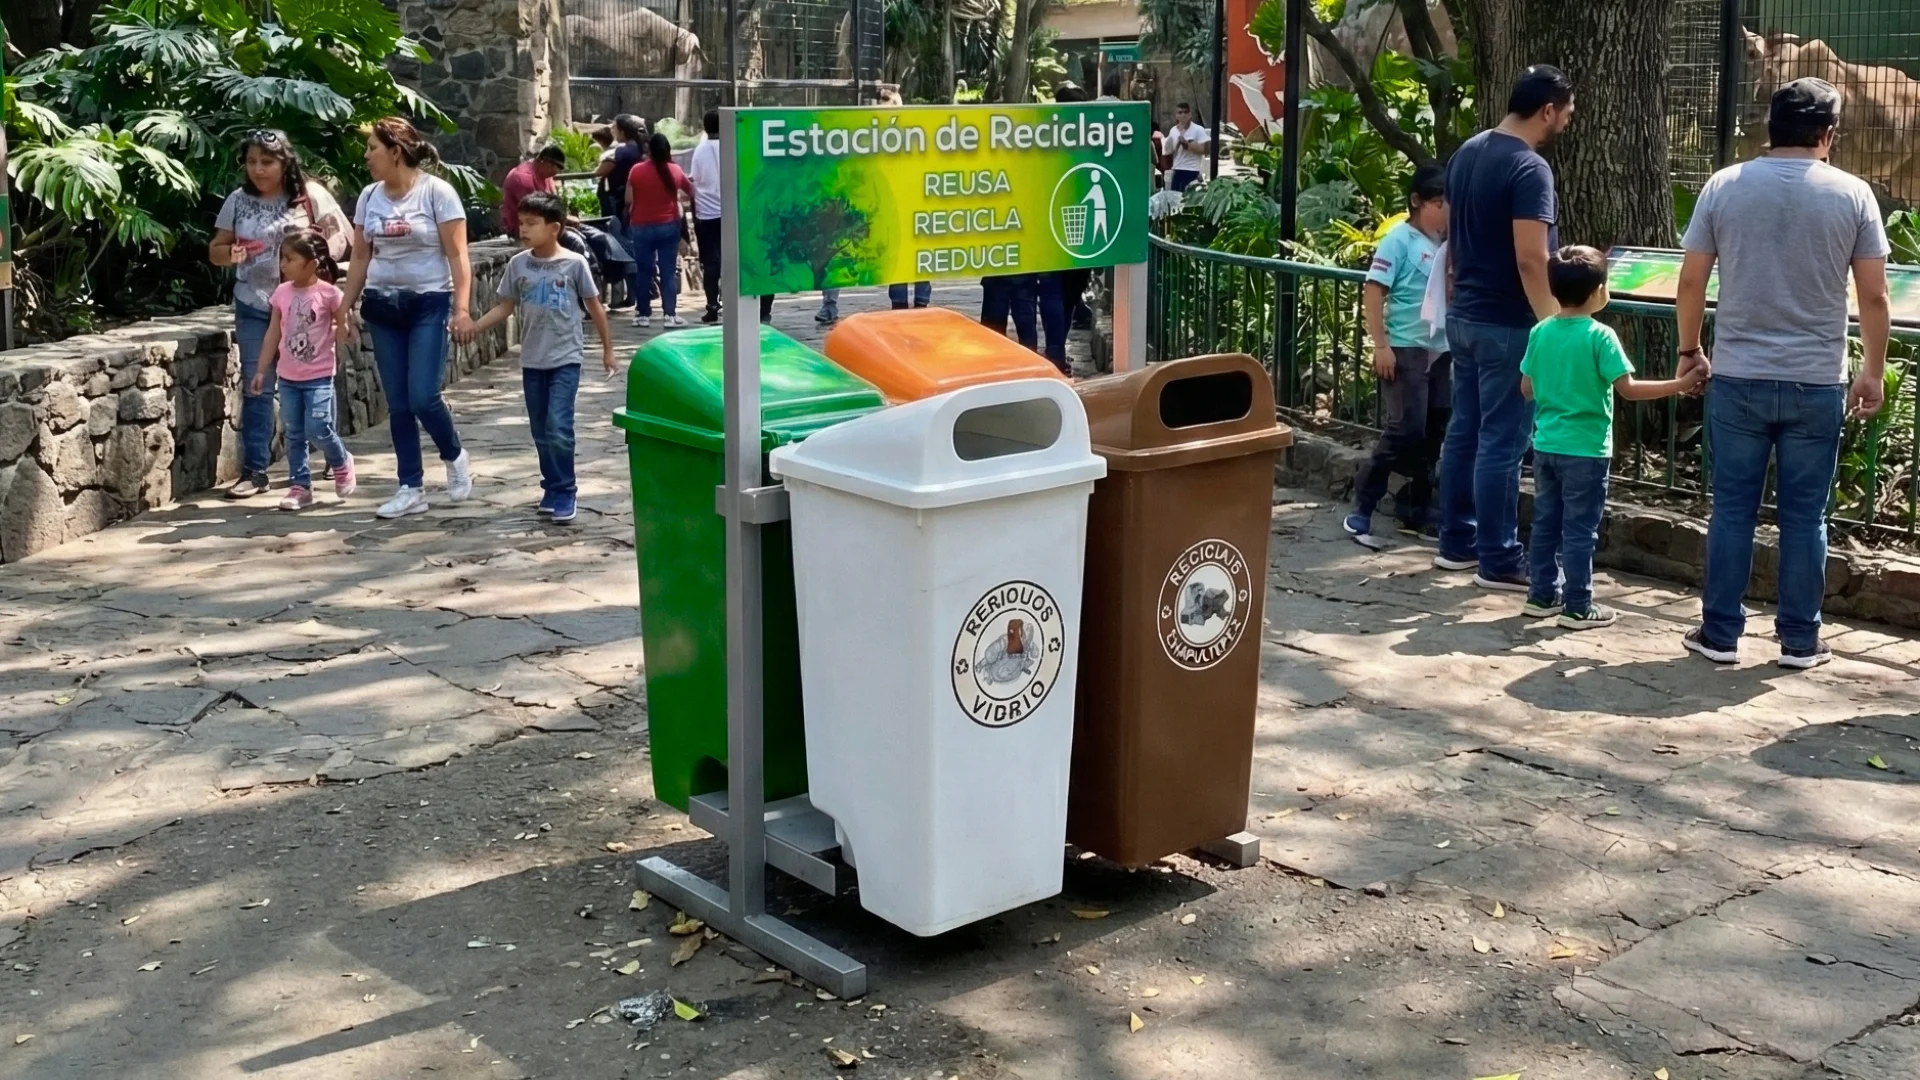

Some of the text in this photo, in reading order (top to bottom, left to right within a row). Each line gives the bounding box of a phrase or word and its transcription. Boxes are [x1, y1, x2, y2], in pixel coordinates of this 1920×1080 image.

[761, 112, 1134, 157] Estación de Reciclaje
[924, 170, 1011, 197] REUSA
[914, 207, 1022, 236] RECICLA
[916, 244, 1019, 274] REDUCE
[973, 680, 1046, 721] VIDRIO
